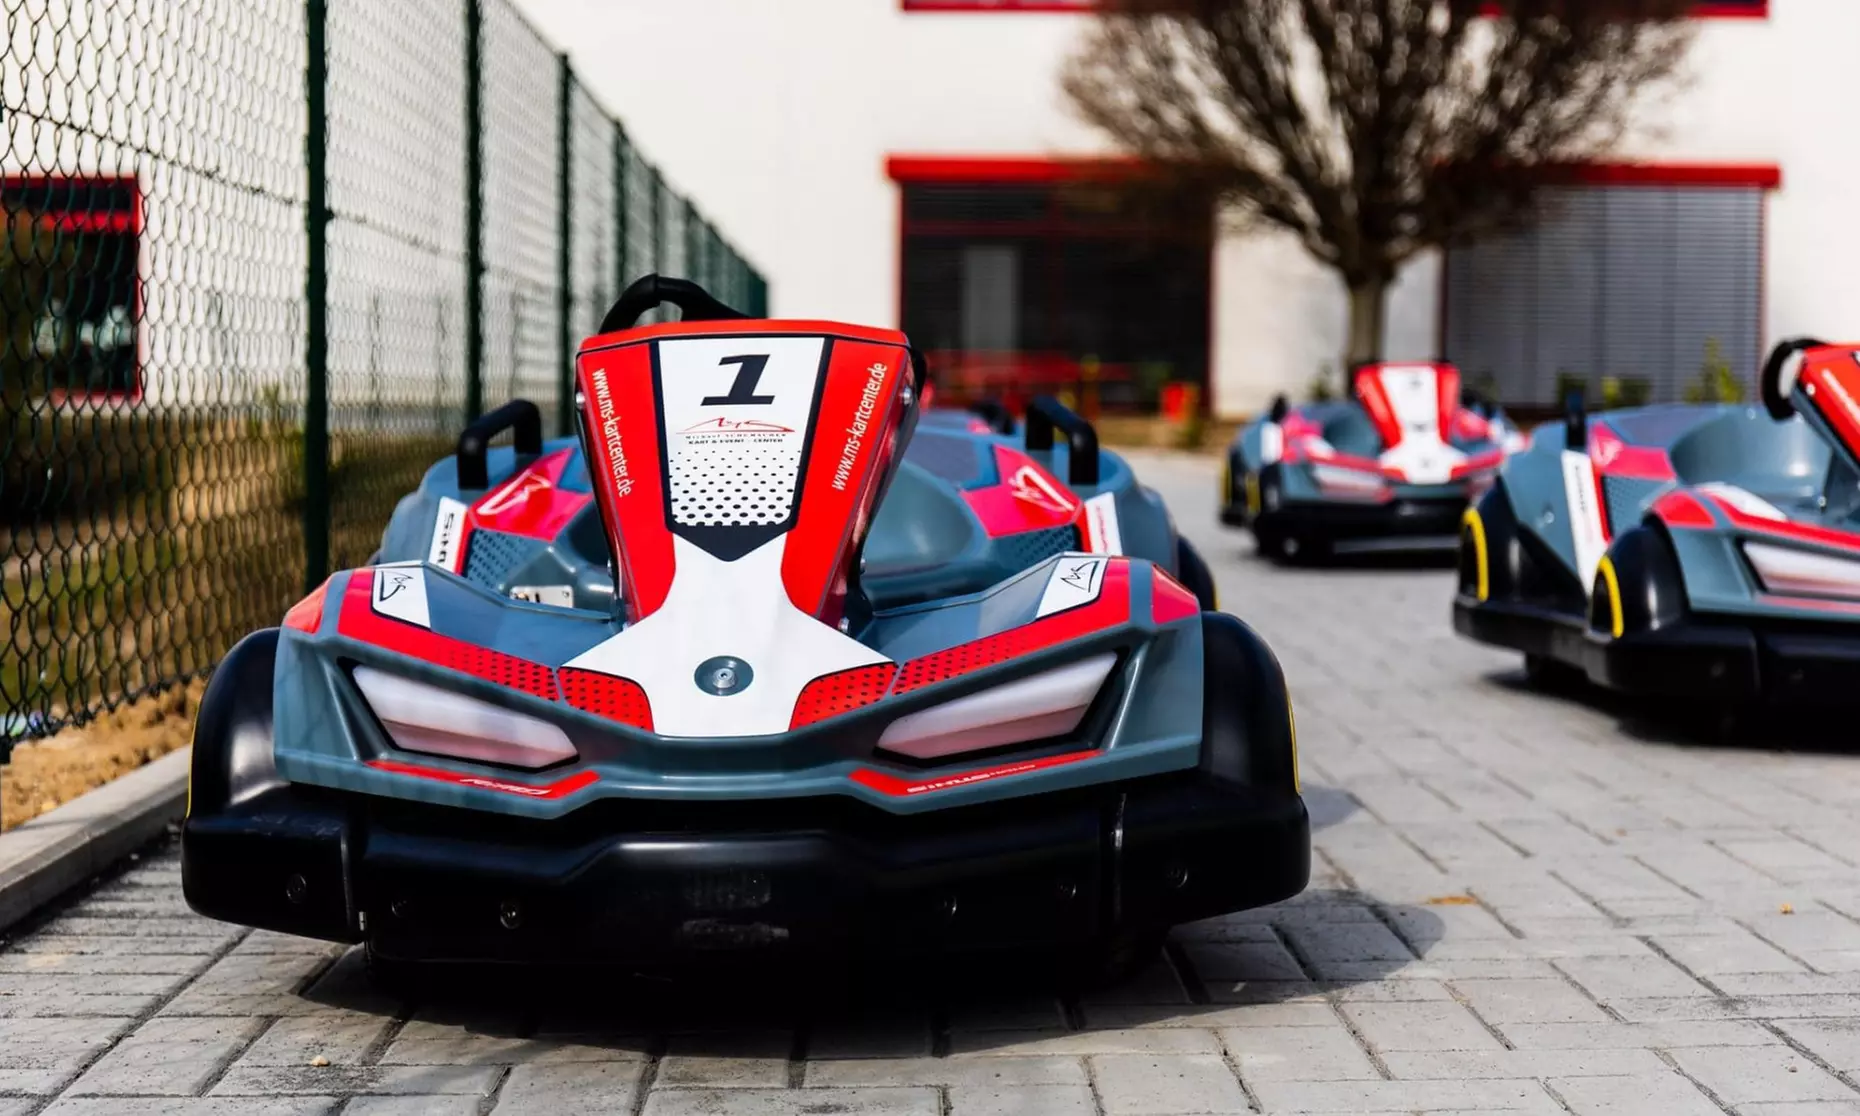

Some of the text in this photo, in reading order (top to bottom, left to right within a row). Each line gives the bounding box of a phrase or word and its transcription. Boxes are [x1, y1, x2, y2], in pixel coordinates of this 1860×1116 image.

[592, 368, 635, 497] www.ms-kartcenter.de
[700, 354, 775, 406] 1
[832, 362, 887, 491] www.ms-kartcenter.de
